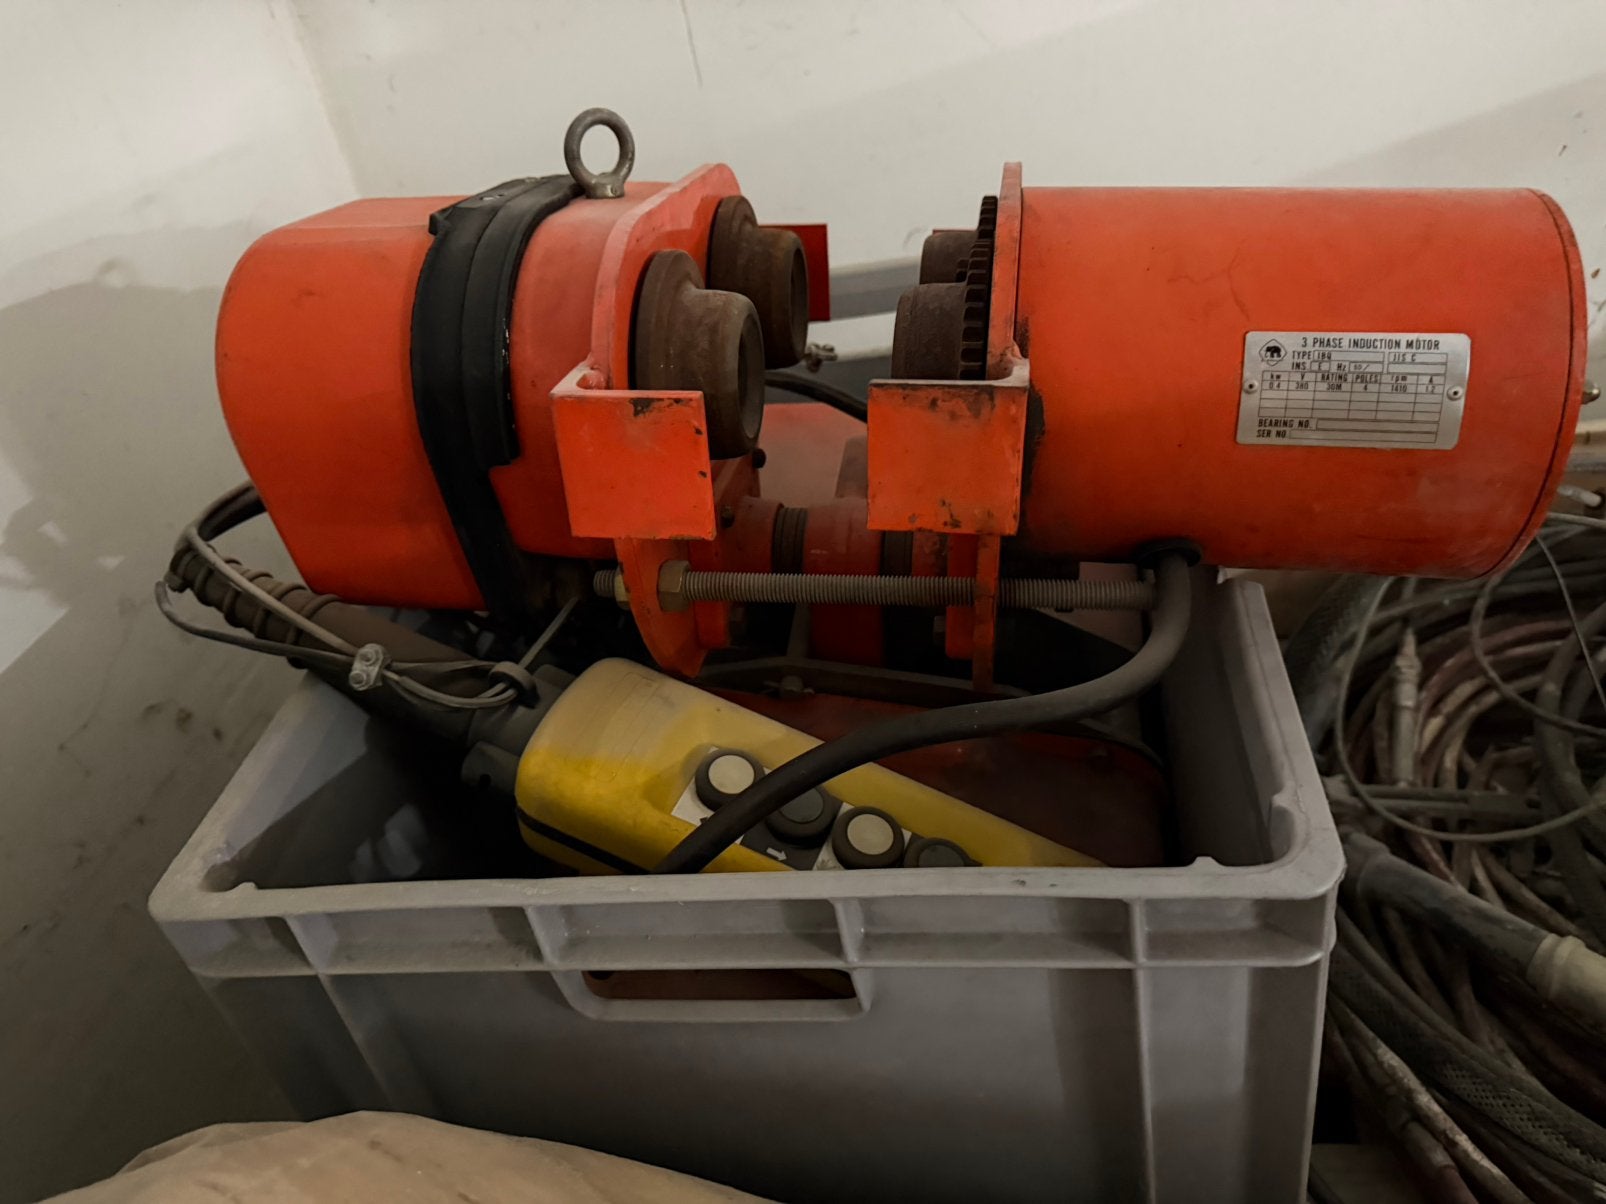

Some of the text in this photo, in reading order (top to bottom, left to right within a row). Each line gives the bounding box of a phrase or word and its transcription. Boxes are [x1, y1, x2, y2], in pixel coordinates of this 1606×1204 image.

[1302, 337, 1441, 350] 3 PHASE INDUCTION MOTOR
[1292, 350, 1312, 360] TYPE
[1392, 352, 1417, 362] JIS C
[1291, 361, 1307, 371] INS
[1336, 362, 1347, 372] Hz
[1300, 373, 1306, 381] V
[1320, 373, 1348, 382] RATING
[1354, 374, 1379, 384] POLES
[1391, 375, 1408, 384] rpm
[1428, 376, 1434, 384] A
[1257, 418, 1294, 428] BEARING
[1256, 429, 1272, 438] SER
